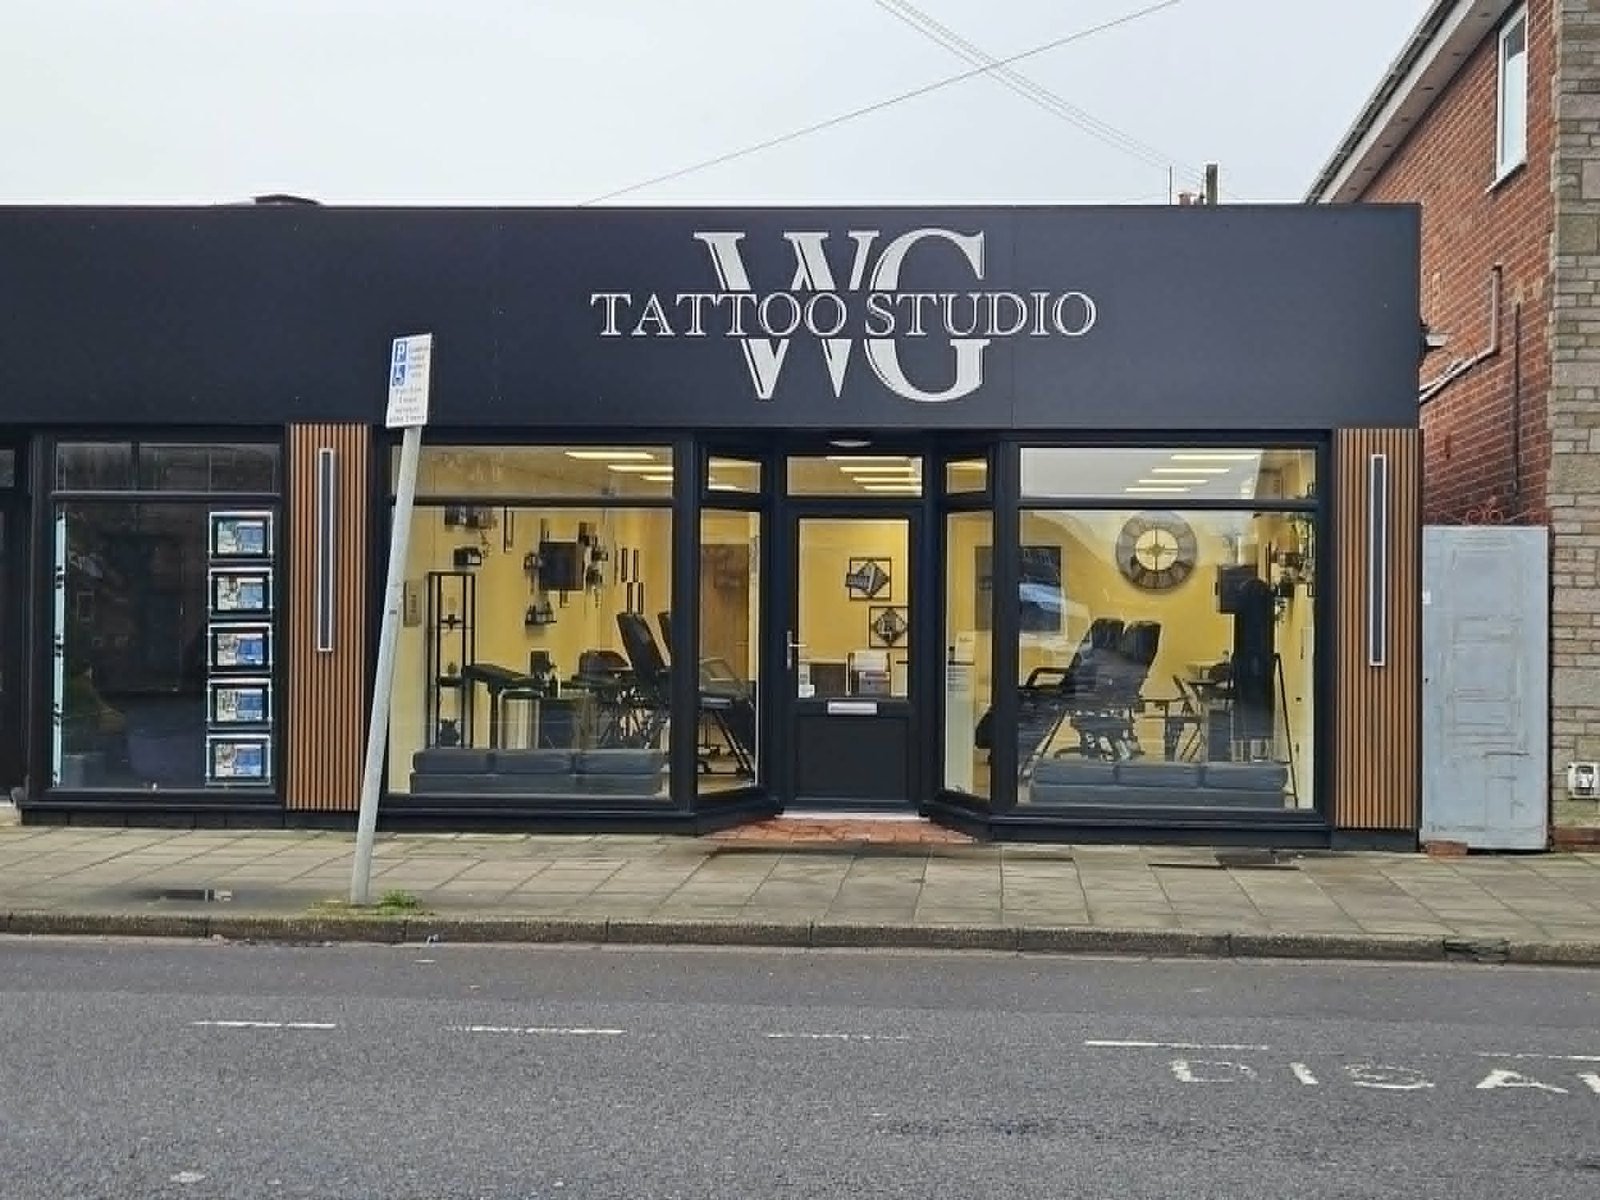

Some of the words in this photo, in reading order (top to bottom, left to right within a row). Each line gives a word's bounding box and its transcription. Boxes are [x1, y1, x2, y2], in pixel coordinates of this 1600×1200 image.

[591, 292, 847, 337] TATTOO
[865, 291, 1097, 337] STUDIO
[692, 227, 991, 402] WG
[1169, 1059, 1600, 1094] DISA
